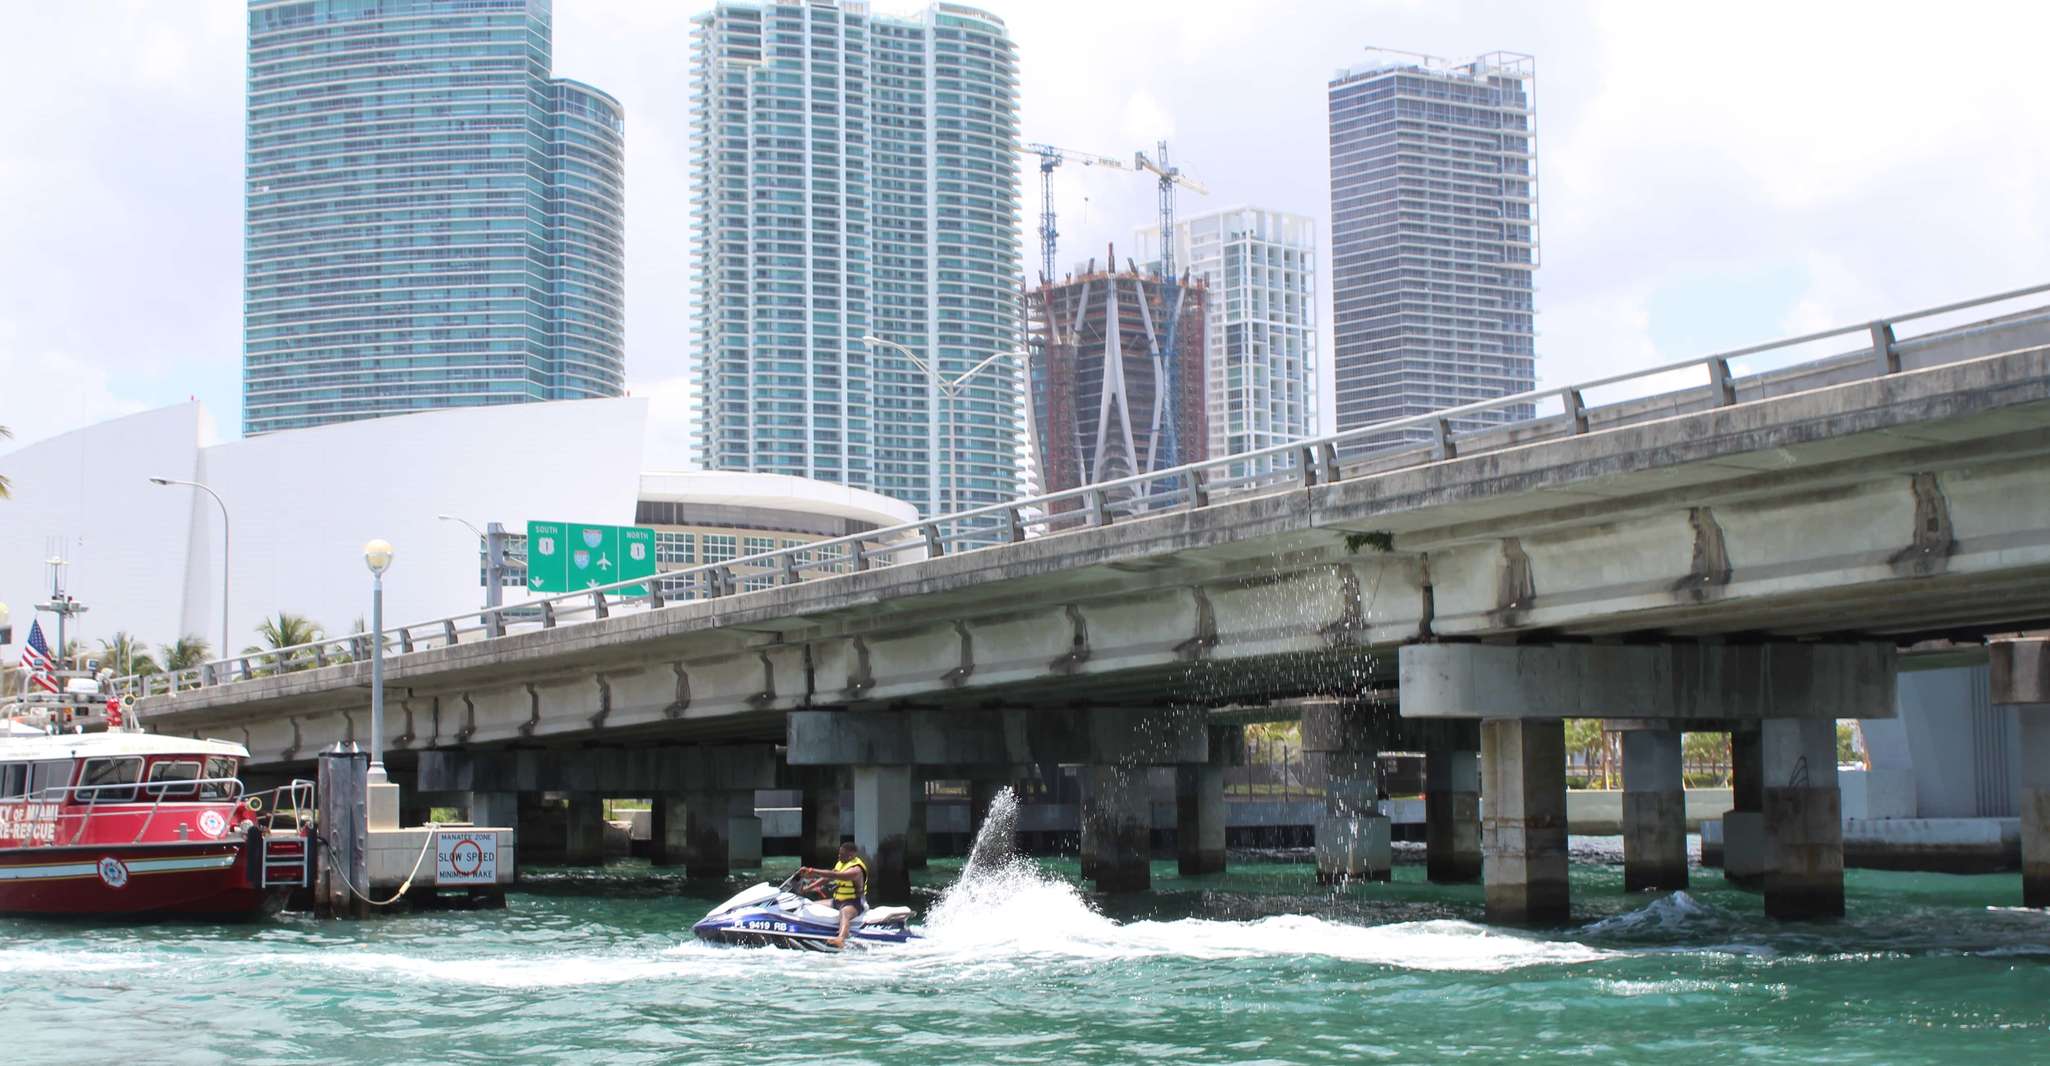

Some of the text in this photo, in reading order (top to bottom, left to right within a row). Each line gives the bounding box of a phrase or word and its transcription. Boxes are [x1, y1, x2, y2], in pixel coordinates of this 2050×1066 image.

[535, 525, 558, 534] SOUTH
[626, 531, 649, 540] NORTH
[27, 804, 59, 821] MIAMI
[439, 852, 494, 861] SLOW SPEED
[734, 920, 746, 929] FL
[749, 920, 771, 930] 9419
